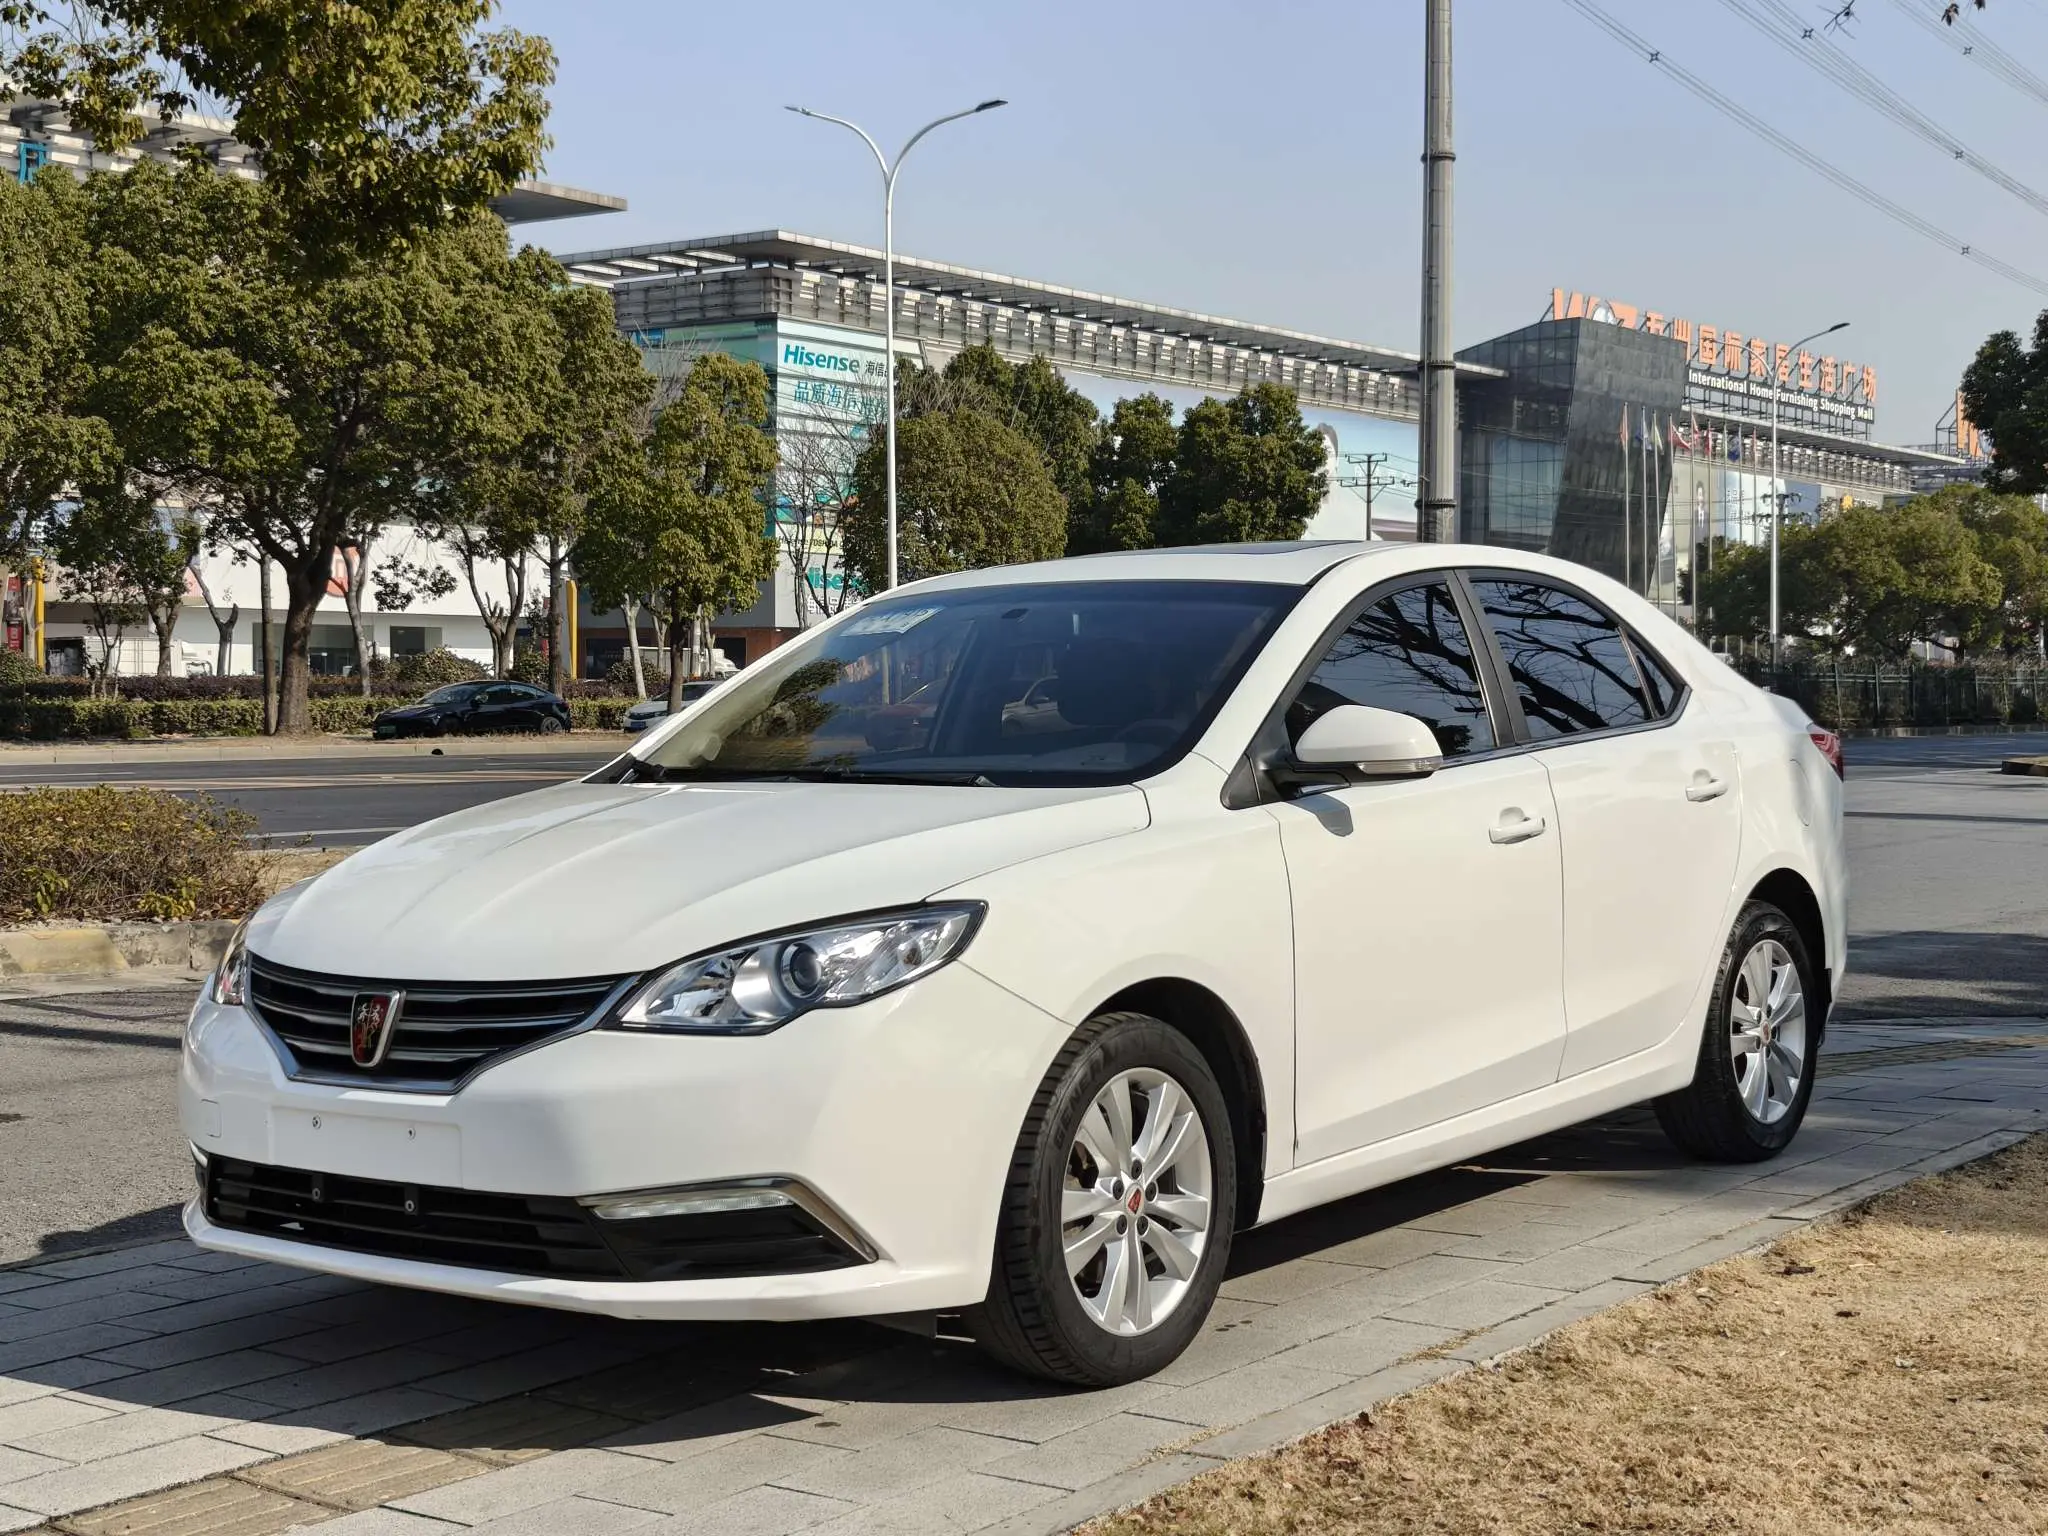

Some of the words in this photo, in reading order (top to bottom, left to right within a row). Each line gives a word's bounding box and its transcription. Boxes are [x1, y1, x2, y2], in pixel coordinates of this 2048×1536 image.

[784, 343, 860, 374] Hisense
[864, 360, 888, 378] 海信
[1688, 369, 1748, 394] International
[1750, 380, 1774, 400] Home
[1776, 388, 1818, 412] Furnishing
[1820, 398, 1856, 420] Shopping
[1857, 406, 1873, 421] Mall
